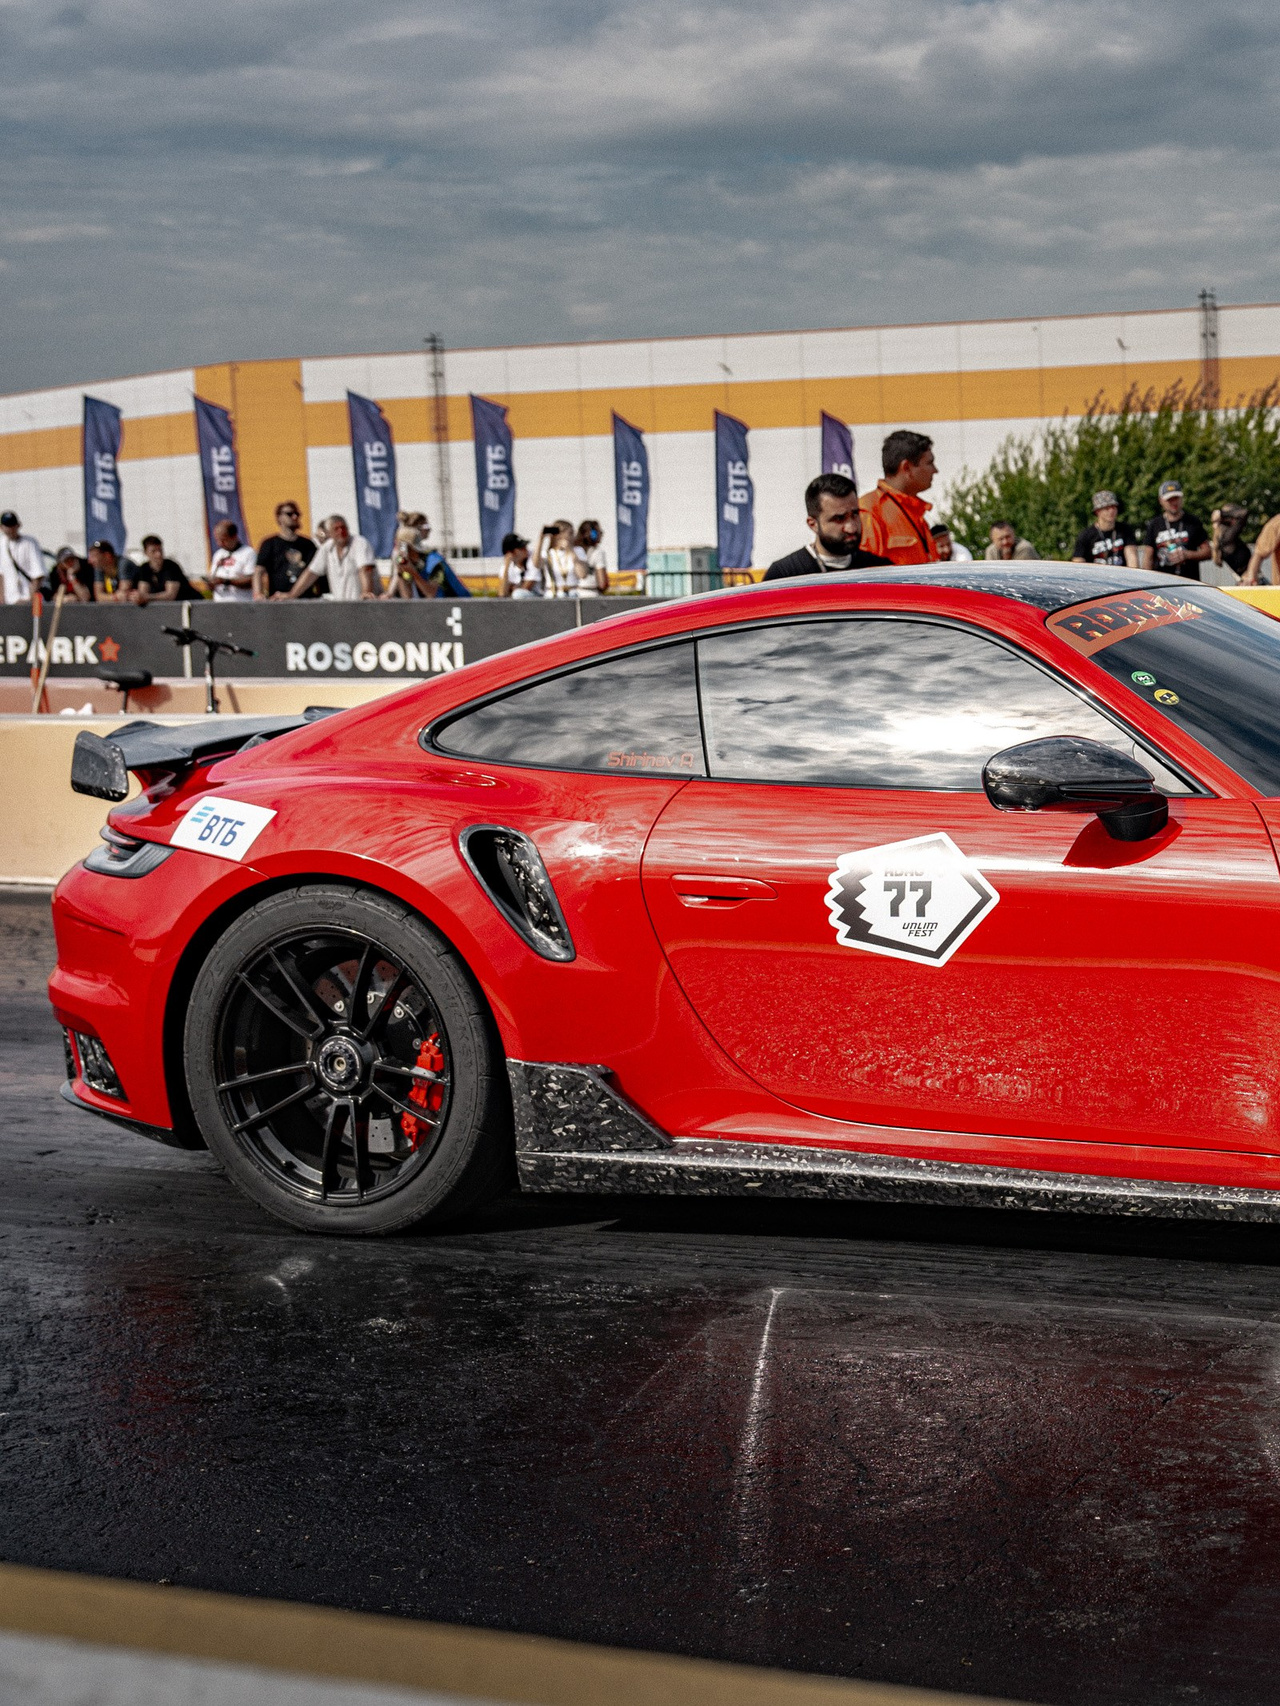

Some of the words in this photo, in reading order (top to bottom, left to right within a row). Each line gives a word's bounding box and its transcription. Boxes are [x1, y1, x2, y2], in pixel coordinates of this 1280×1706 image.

[93, 451, 116, 500] ВТБ
[211, 445, 236, 492] ВТБ
[364, 440, 389, 488] ВТБ
[486, 444, 510, 490] ВТБ
[622, 460, 642, 506] ВТБ
[727, 460, 749, 504] ВТБ
[0, 635, 99, 664] PARK
[286, 641, 464, 672] ROSGONKI
[607, 751, 676, 768] Shirinov
[680, 752, 695, 768] A
[198, 814, 246, 847] ВТБ
[883, 880, 932, 918] 77
[902, 922, 938, 930] UNLIM
[907, 929, 935, 938] FEST
